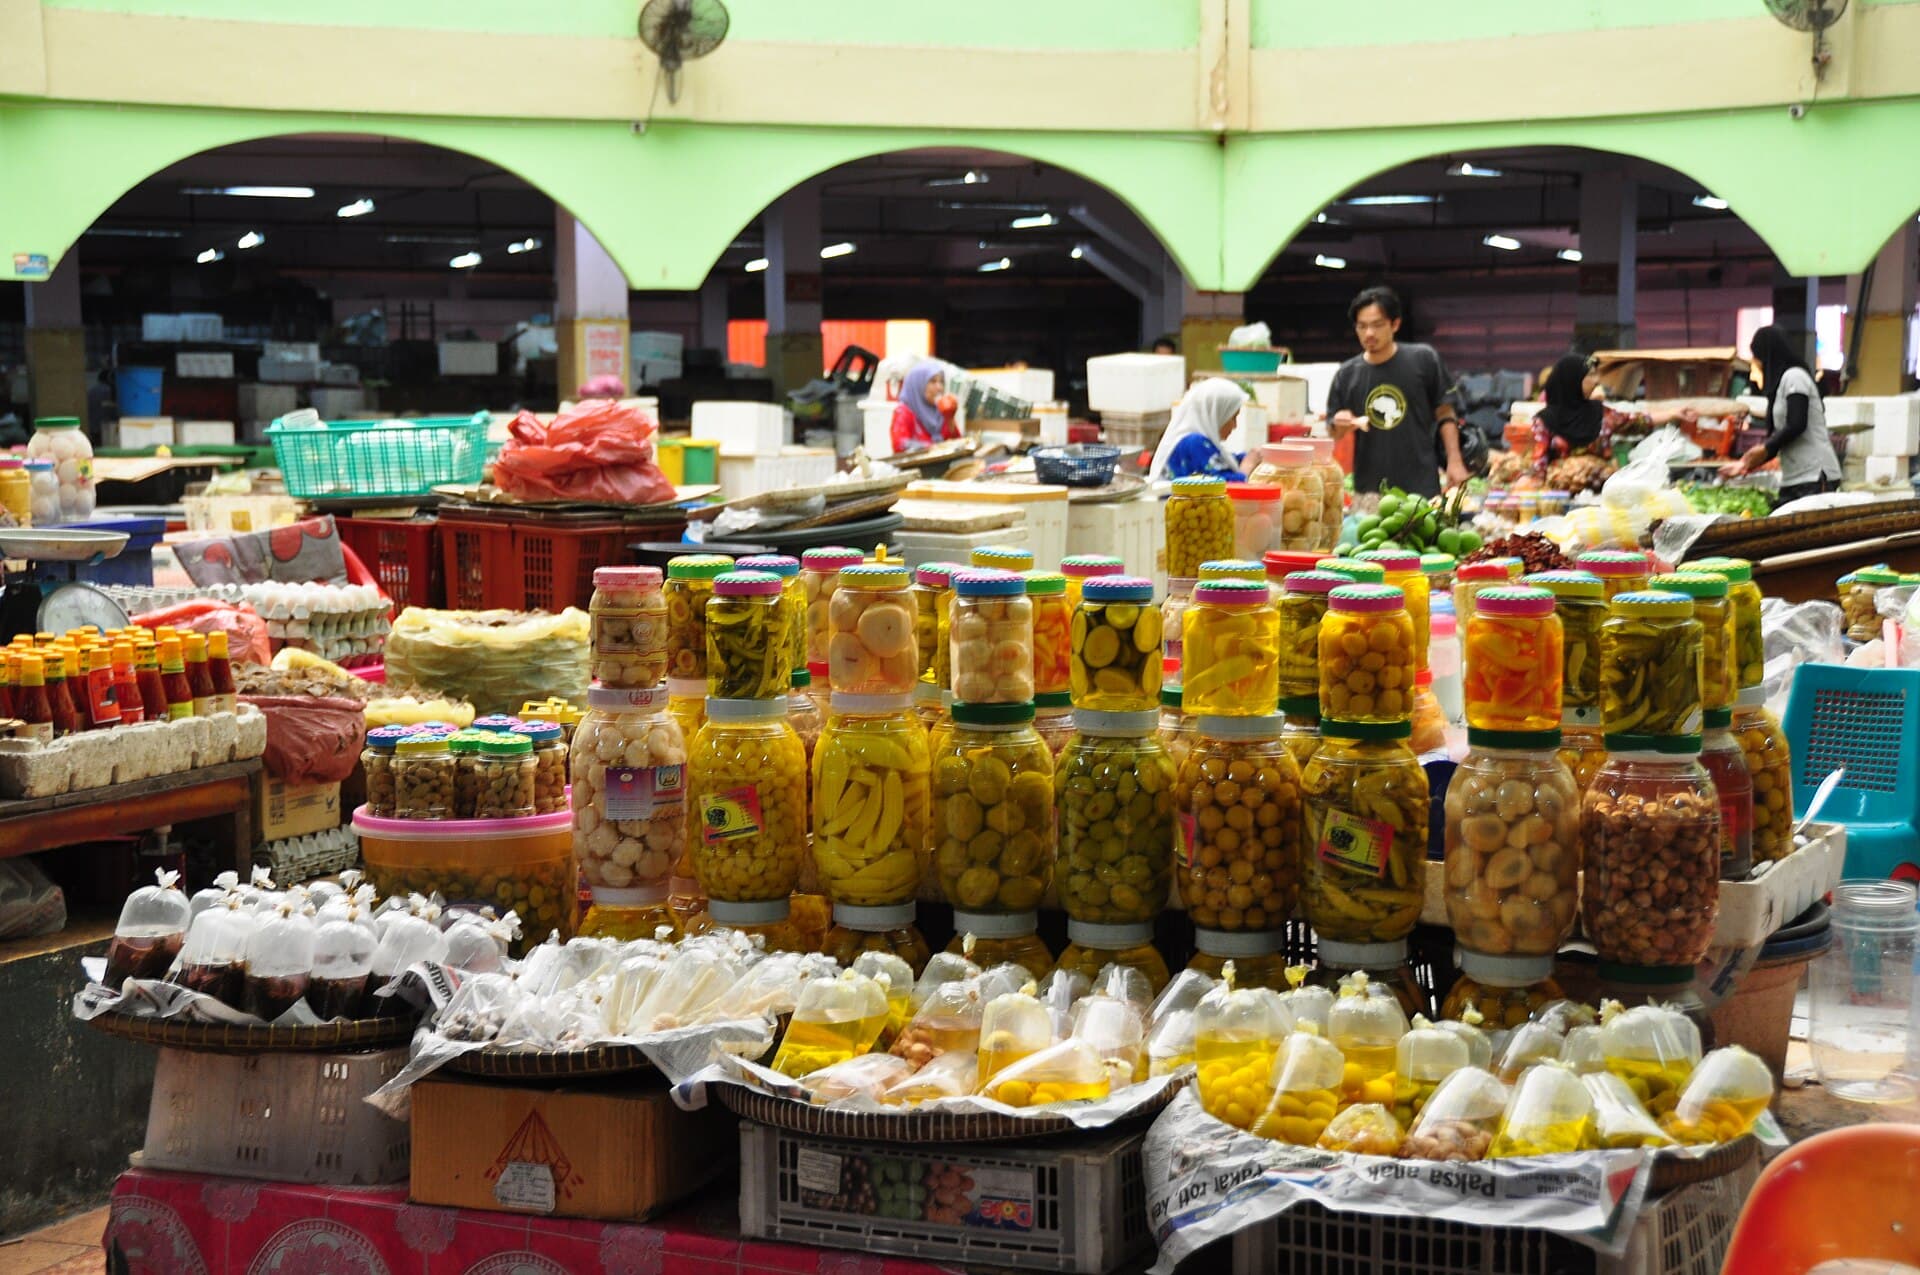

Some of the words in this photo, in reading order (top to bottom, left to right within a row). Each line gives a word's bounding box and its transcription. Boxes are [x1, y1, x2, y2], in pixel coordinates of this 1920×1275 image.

[1367, 1165, 1420, 1181] anak
[1429, 1167, 1496, 1197] Paksa
[981, 1200, 1032, 1227] Dole
